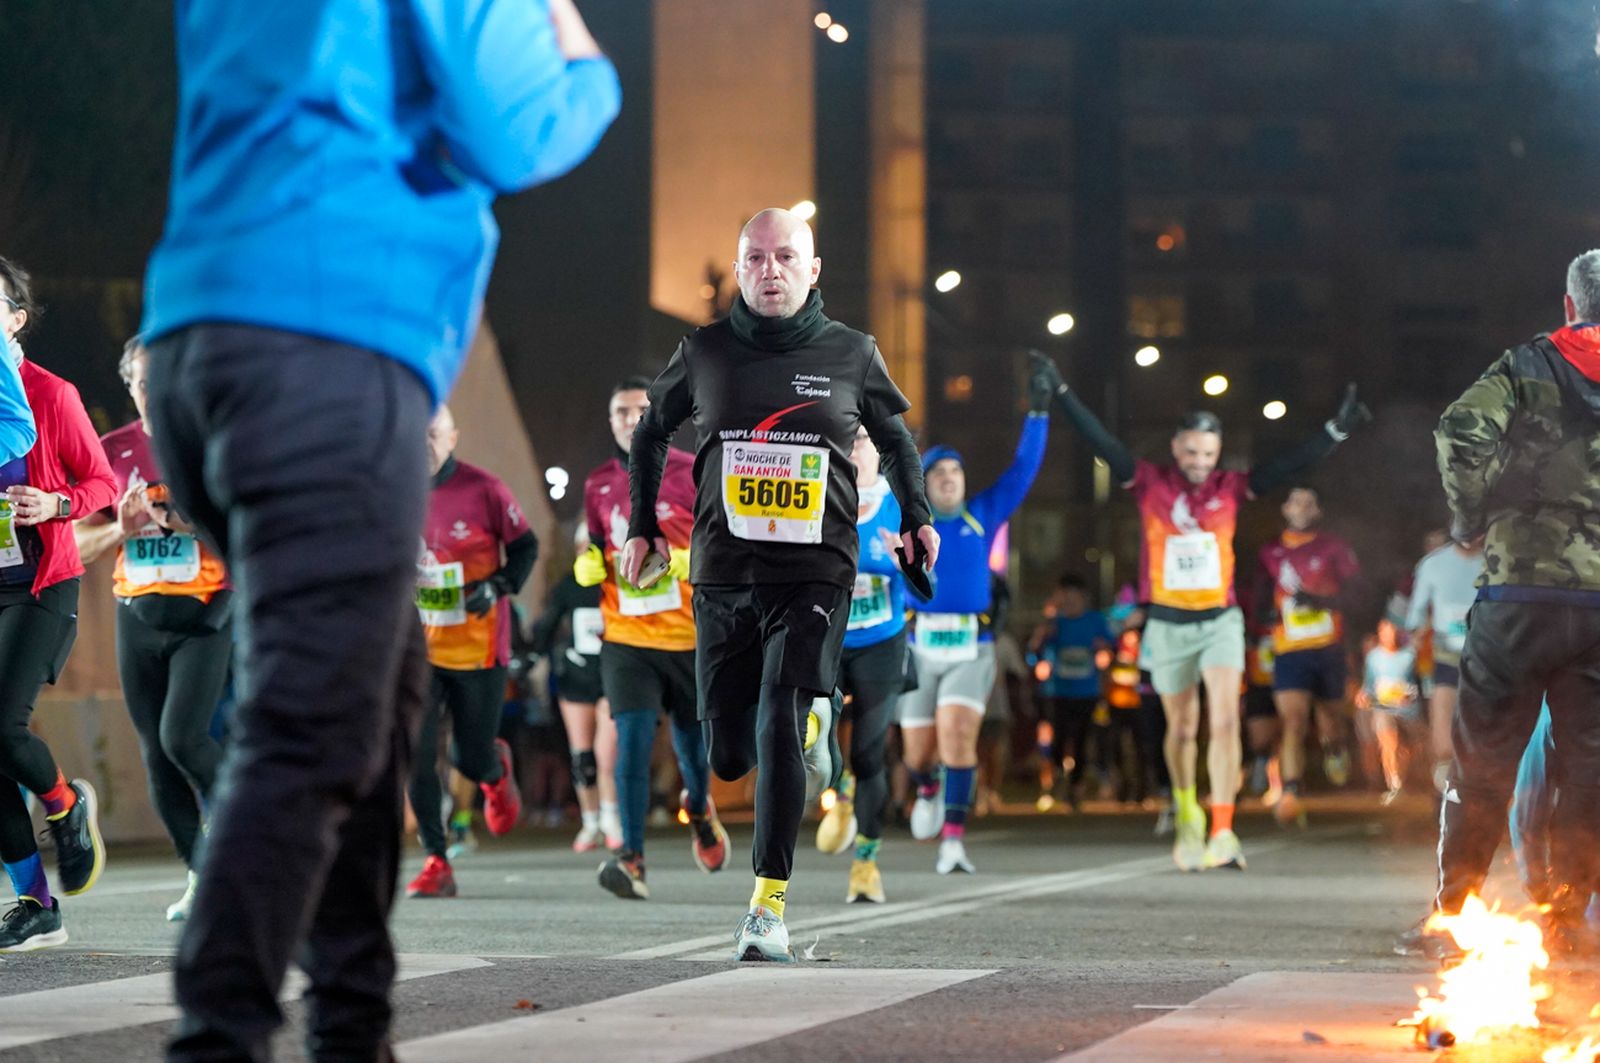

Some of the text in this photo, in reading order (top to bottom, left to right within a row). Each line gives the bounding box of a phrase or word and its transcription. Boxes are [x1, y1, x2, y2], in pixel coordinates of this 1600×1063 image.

[795, 373, 831, 383] Fundación
[795, 385, 831, 398] Cajasol
[745, 454, 792, 466] NOCHE DE
[734, 464, 754, 475] SAN
[739, 478, 810, 510] 5605
[136, 536, 183, 559] 8762
